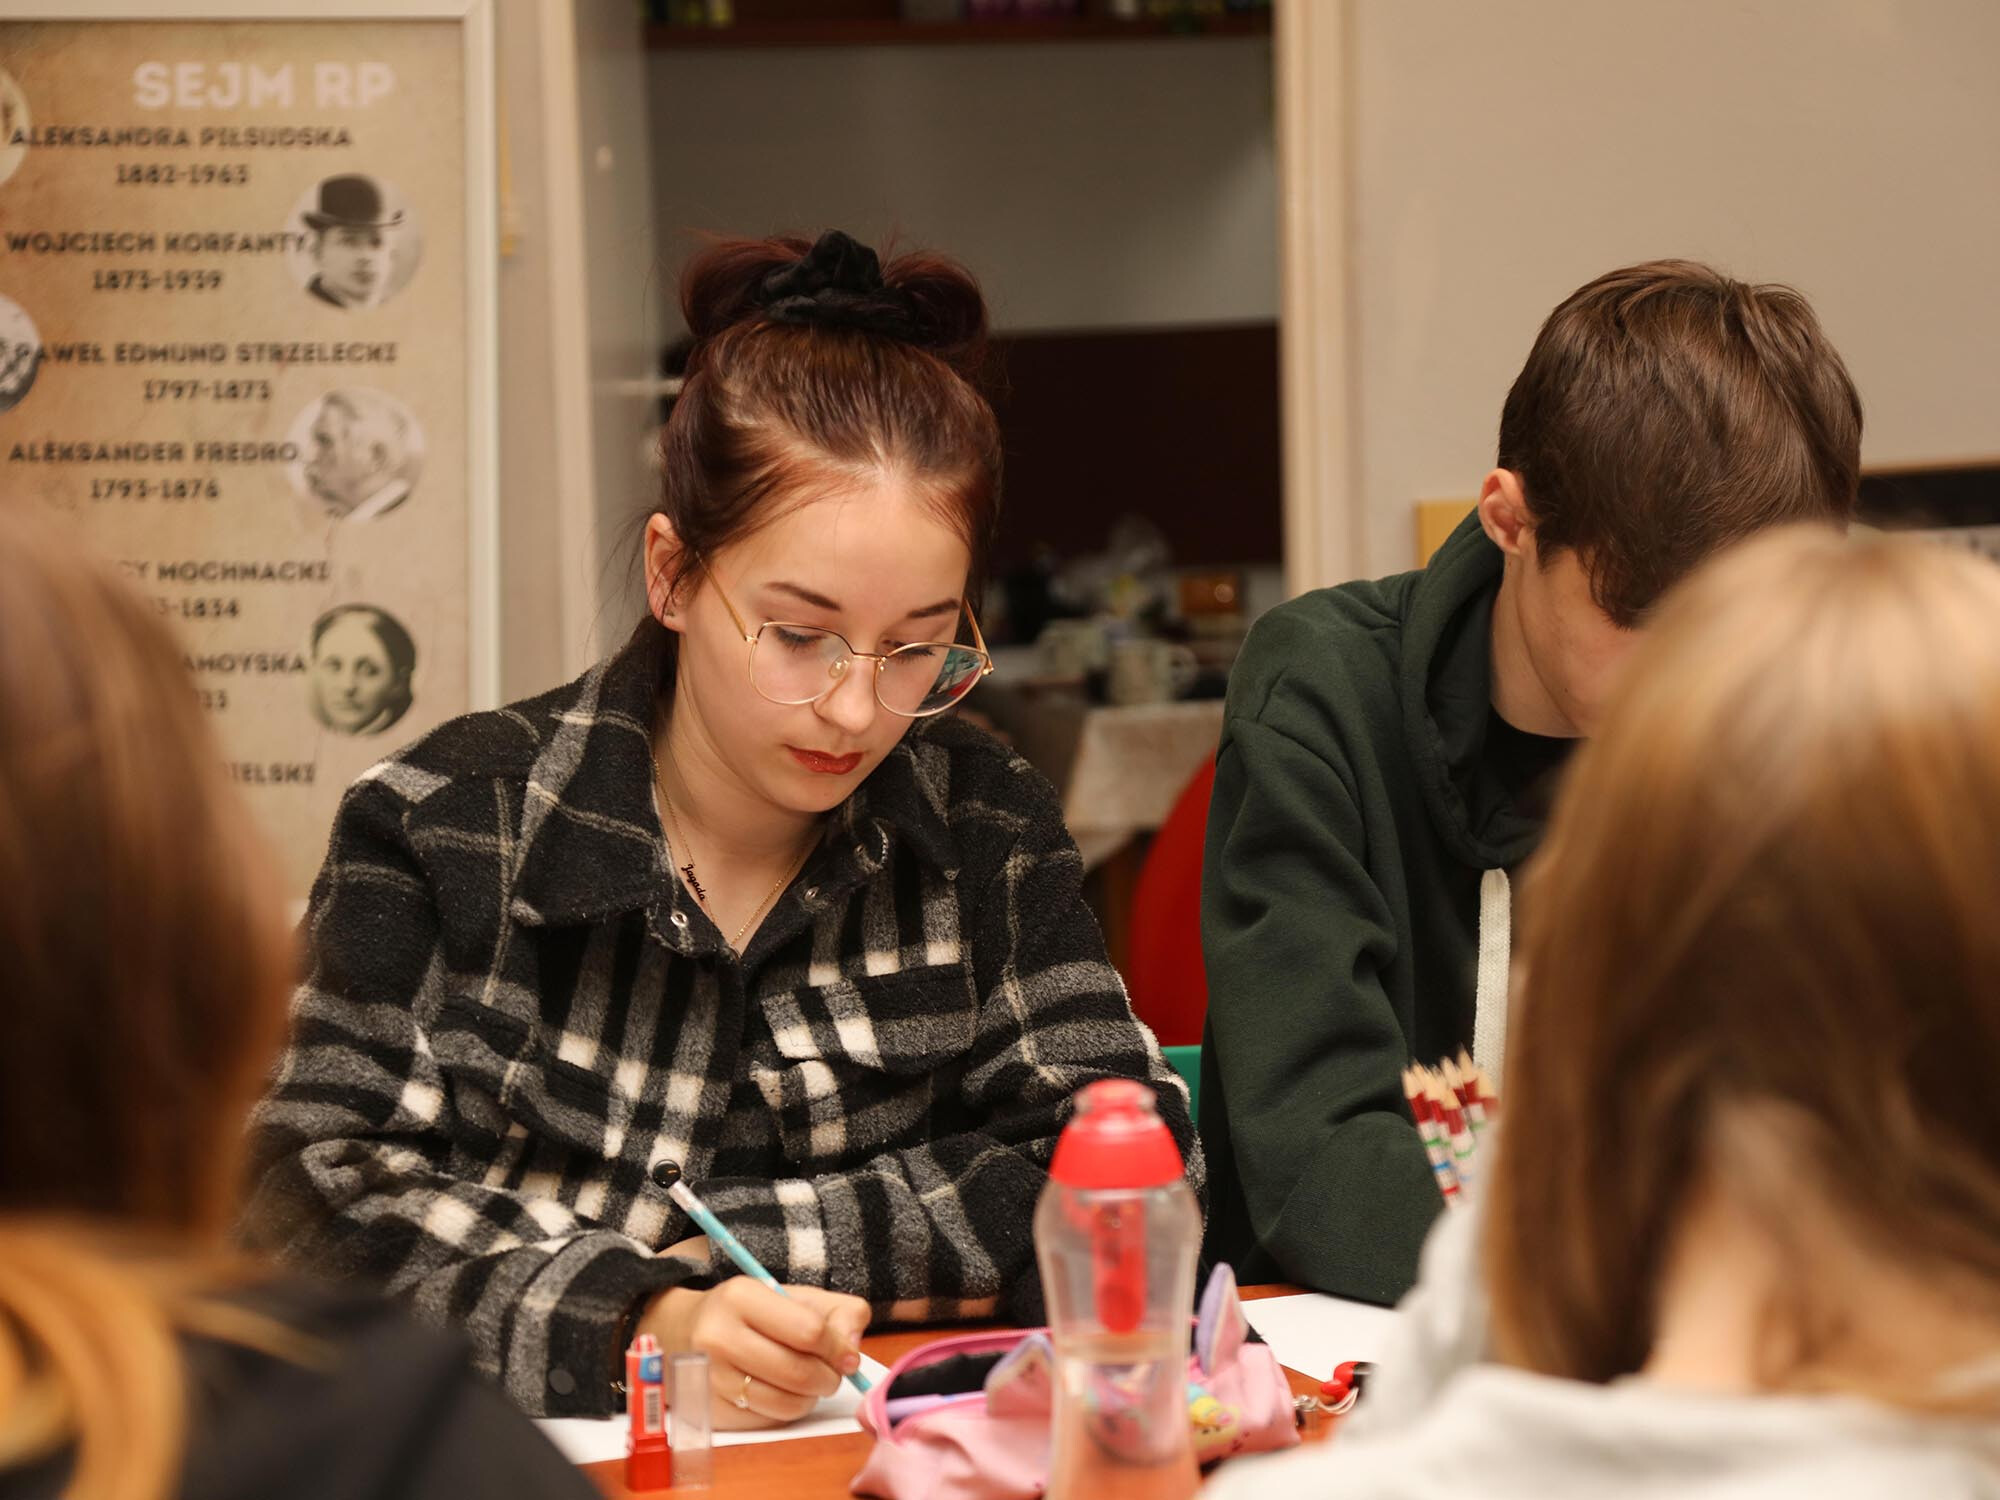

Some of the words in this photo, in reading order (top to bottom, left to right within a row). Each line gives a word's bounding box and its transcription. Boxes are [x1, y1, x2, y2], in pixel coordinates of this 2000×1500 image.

[133, 62, 293, 109] SEJM
[315, 62, 395, 109] RP
[10, 126, 190, 147] ALEKSANDRA
[116, 163, 249, 185] 1882-1963
[7, 232, 156, 252] WOJCIECH
[166, 231, 306, 252] KORFANTY
[93, 269, 223, 290] 1873-1939
[114, 342, 227, 363] EDMUND
[236, 342, 398, 363] STRZELECKI
[143, 379, 272, 401] 1797-1873
[9, 442, 185, 463] ALEKSANDER
[194, 442, 298, 463] FREDRO
[91, 478, 219, 499] 1793-1876
[157, 560, 330, 582] MOCHNACKI
